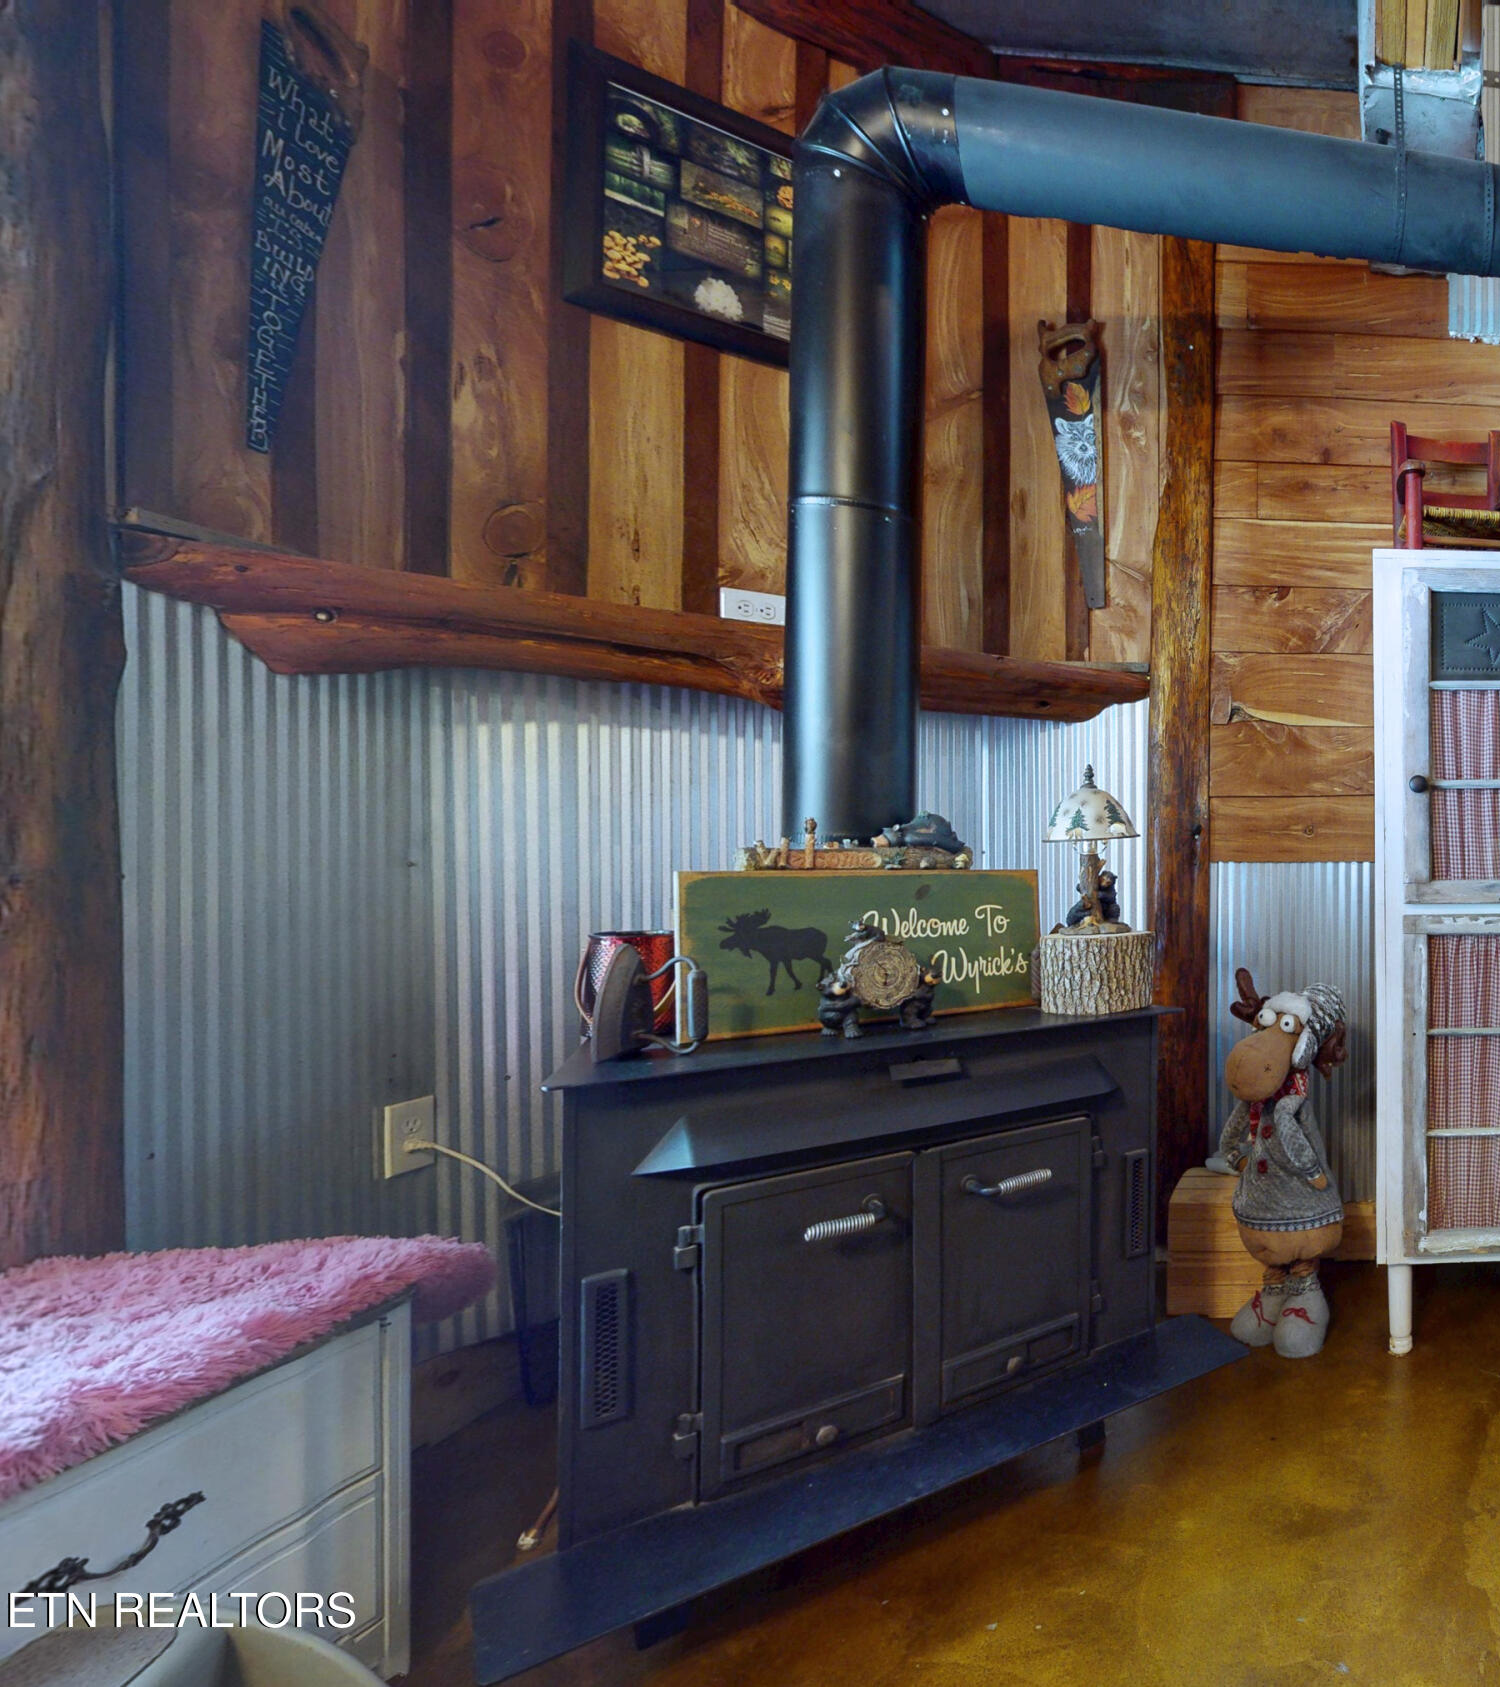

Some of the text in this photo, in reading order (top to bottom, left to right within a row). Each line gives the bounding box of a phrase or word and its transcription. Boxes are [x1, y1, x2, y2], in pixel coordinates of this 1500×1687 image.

[267, 64, 334, 143] What
[262, 129, 332, 195] Most
[263, 170, 333, 227] About
[862, 904, 1010, 938] Welcome To
[931, 946, 1029, 994] Wyrick's
